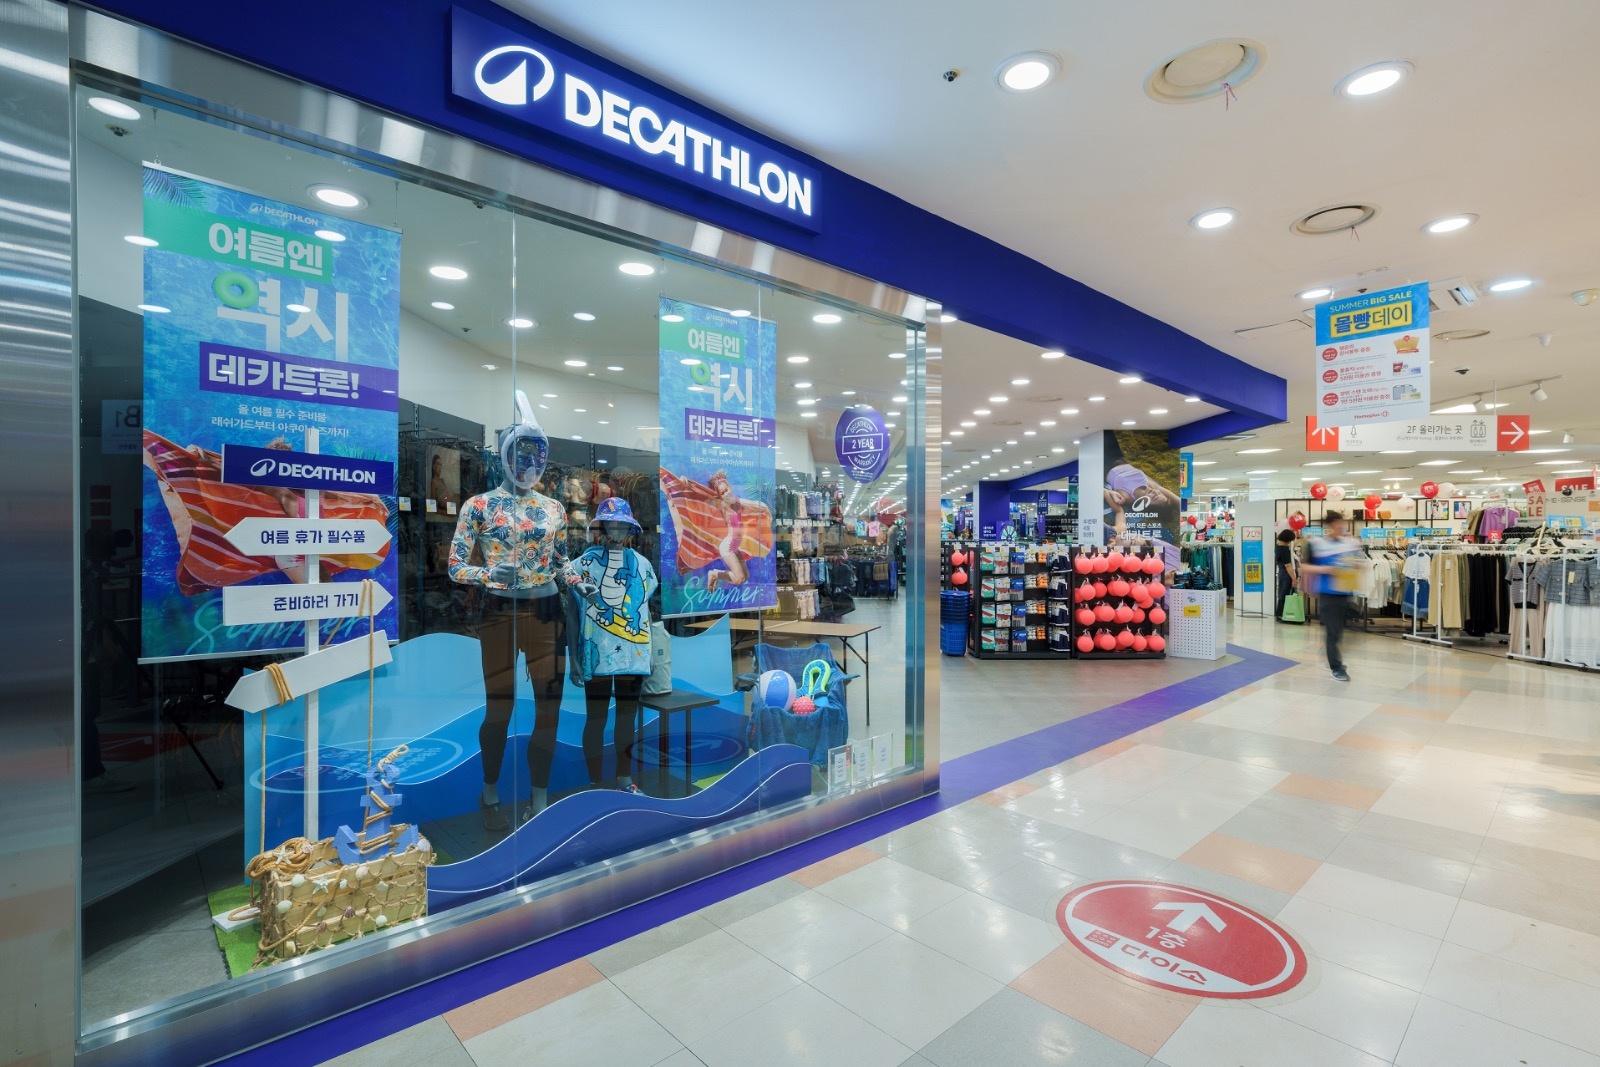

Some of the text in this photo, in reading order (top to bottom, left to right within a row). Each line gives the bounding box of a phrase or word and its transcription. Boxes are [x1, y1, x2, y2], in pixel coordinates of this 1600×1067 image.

[565, 73, 812, 216] DECATHLON
[264, 206, 319, 226] DECATHLON
[208, 222, 323, 276] 여름엔
[1329, 290, 1413, 313] SUMMER BIG SALE
[213, 270, 349, 363] 역시
[1334, 303, 1409, 334] 몰빵데이
[687, 328, 741, 359] 여름엔
[207, 352, 360, 400] 데카트론!
[690, 361, 753, 417] 역시
[211, 416, 276, 432] 래쉬가드부터
[237, 404, 328, 423] 올 여름 필수 준비물
[688, 414, 760, 441] 데카트론!
[1406, 424, 1463, 435] 2F 올라가는 곳
[852, 438, 875, 449] 2 YEAR
[278, 461, 376, 485] DECATHLON
[260, 529, 366, 545] 여름 휴가 필수품
[273, 593, 360, 611] 준비하러 가기
[679, 575, 764, 614] Summer
[1145, 926, 1188, 950] 1층
[1120, 943, 1208, 986] 다이소
